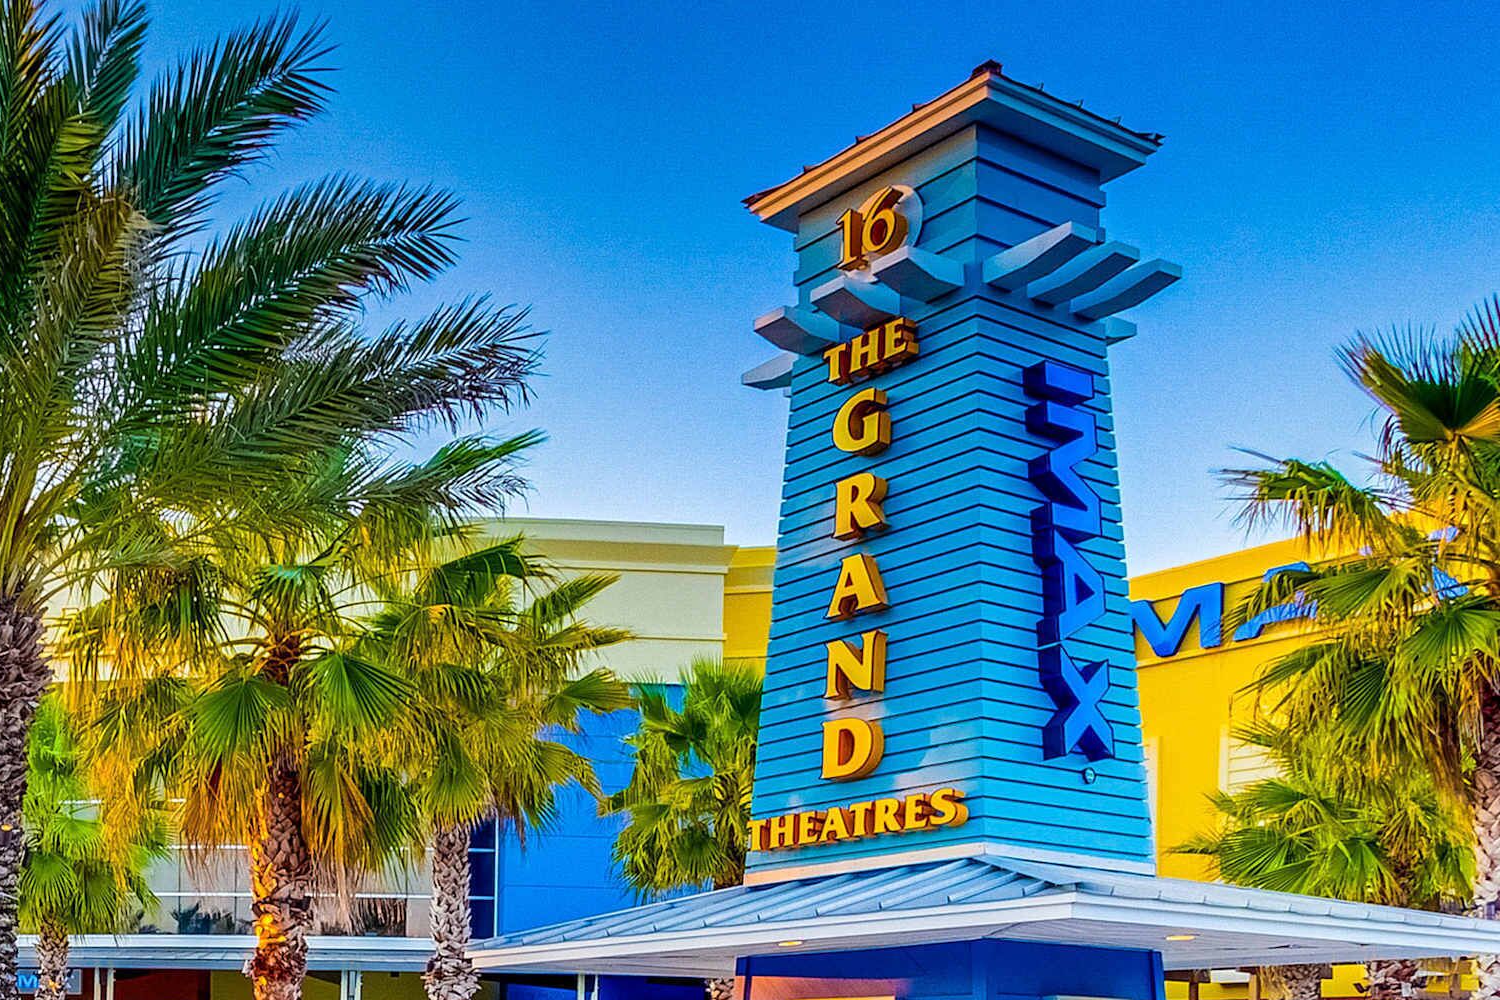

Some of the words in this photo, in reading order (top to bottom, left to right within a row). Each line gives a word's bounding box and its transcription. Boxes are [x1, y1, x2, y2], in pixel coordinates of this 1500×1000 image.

[836, 185, 904, 271] 16
[823, 317, 919, 386] THE
[821, 387, 892, 783] GRAND
[1023, 359, 1116, 762] IMAX
[747, 787, 969, 852] THEATRES
